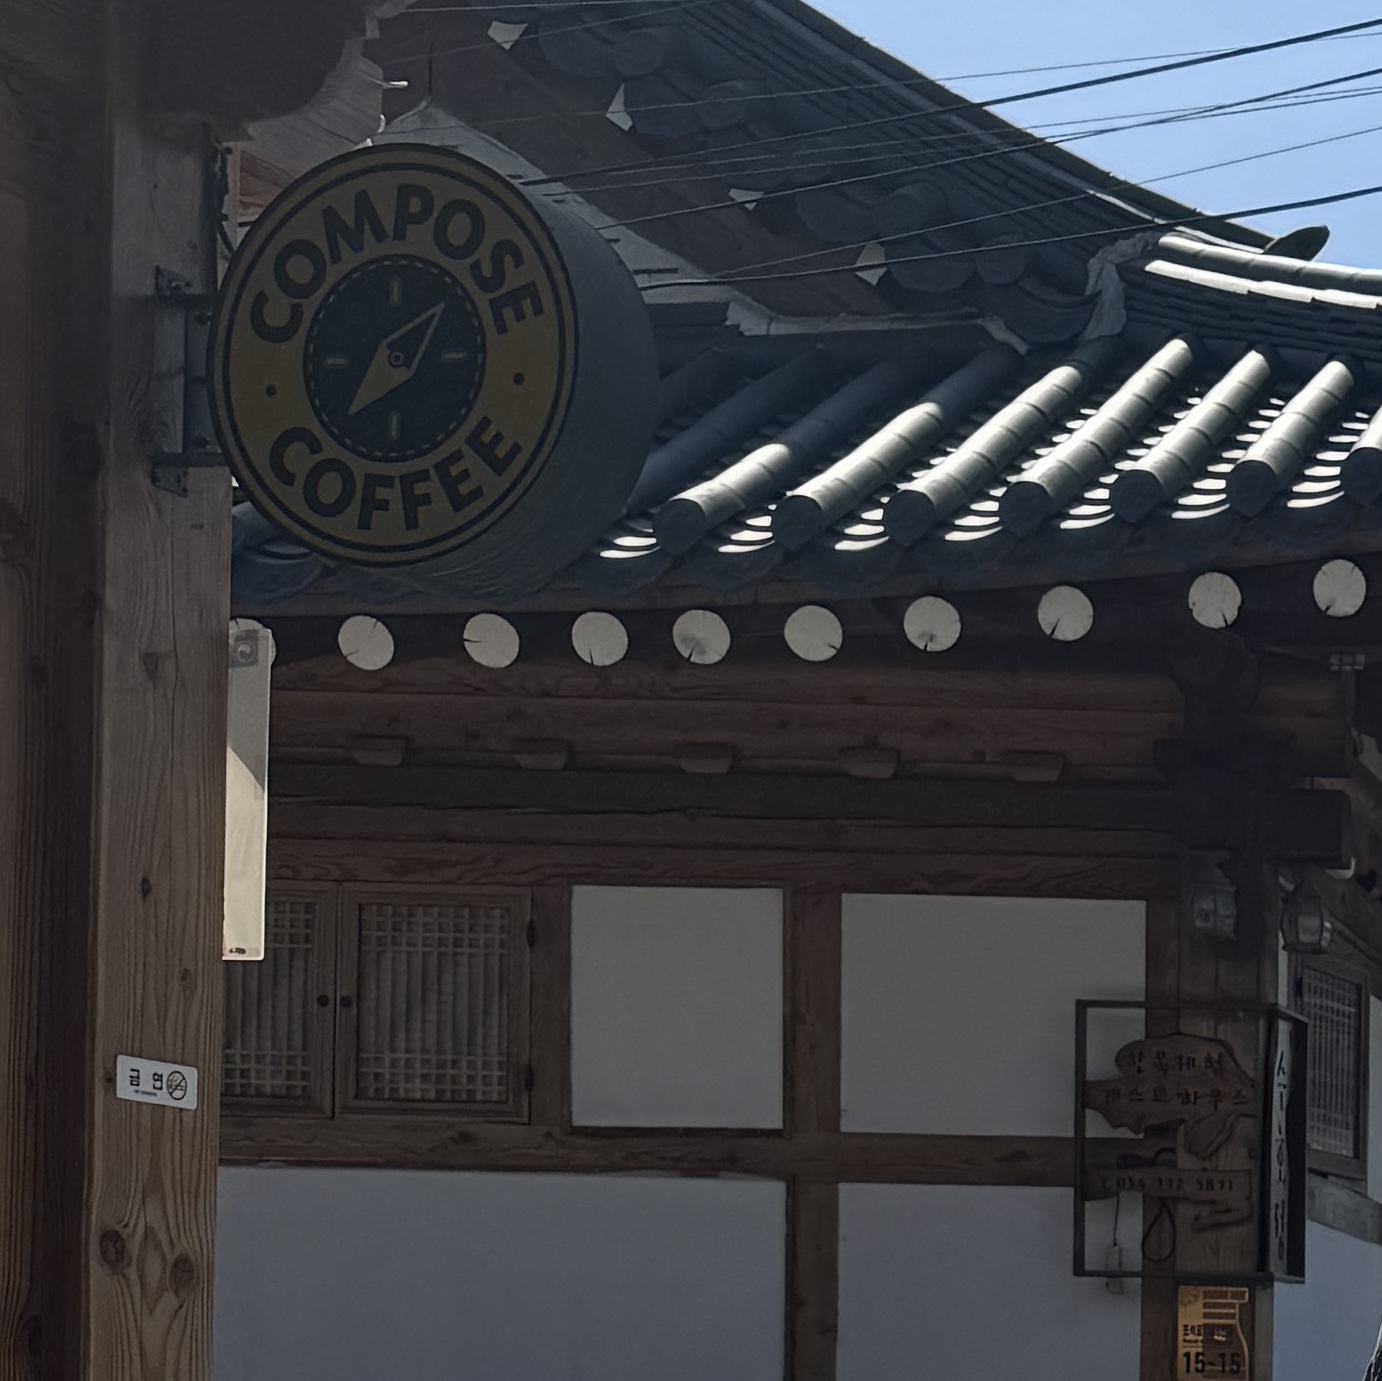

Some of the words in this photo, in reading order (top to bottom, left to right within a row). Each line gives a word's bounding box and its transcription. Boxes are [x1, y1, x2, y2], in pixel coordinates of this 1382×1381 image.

[250, 184, 545, 344] COMPOSE
[269, 416, 522, 531] COFFEE
[1183, 1350, 1241, 1374] 15-15
